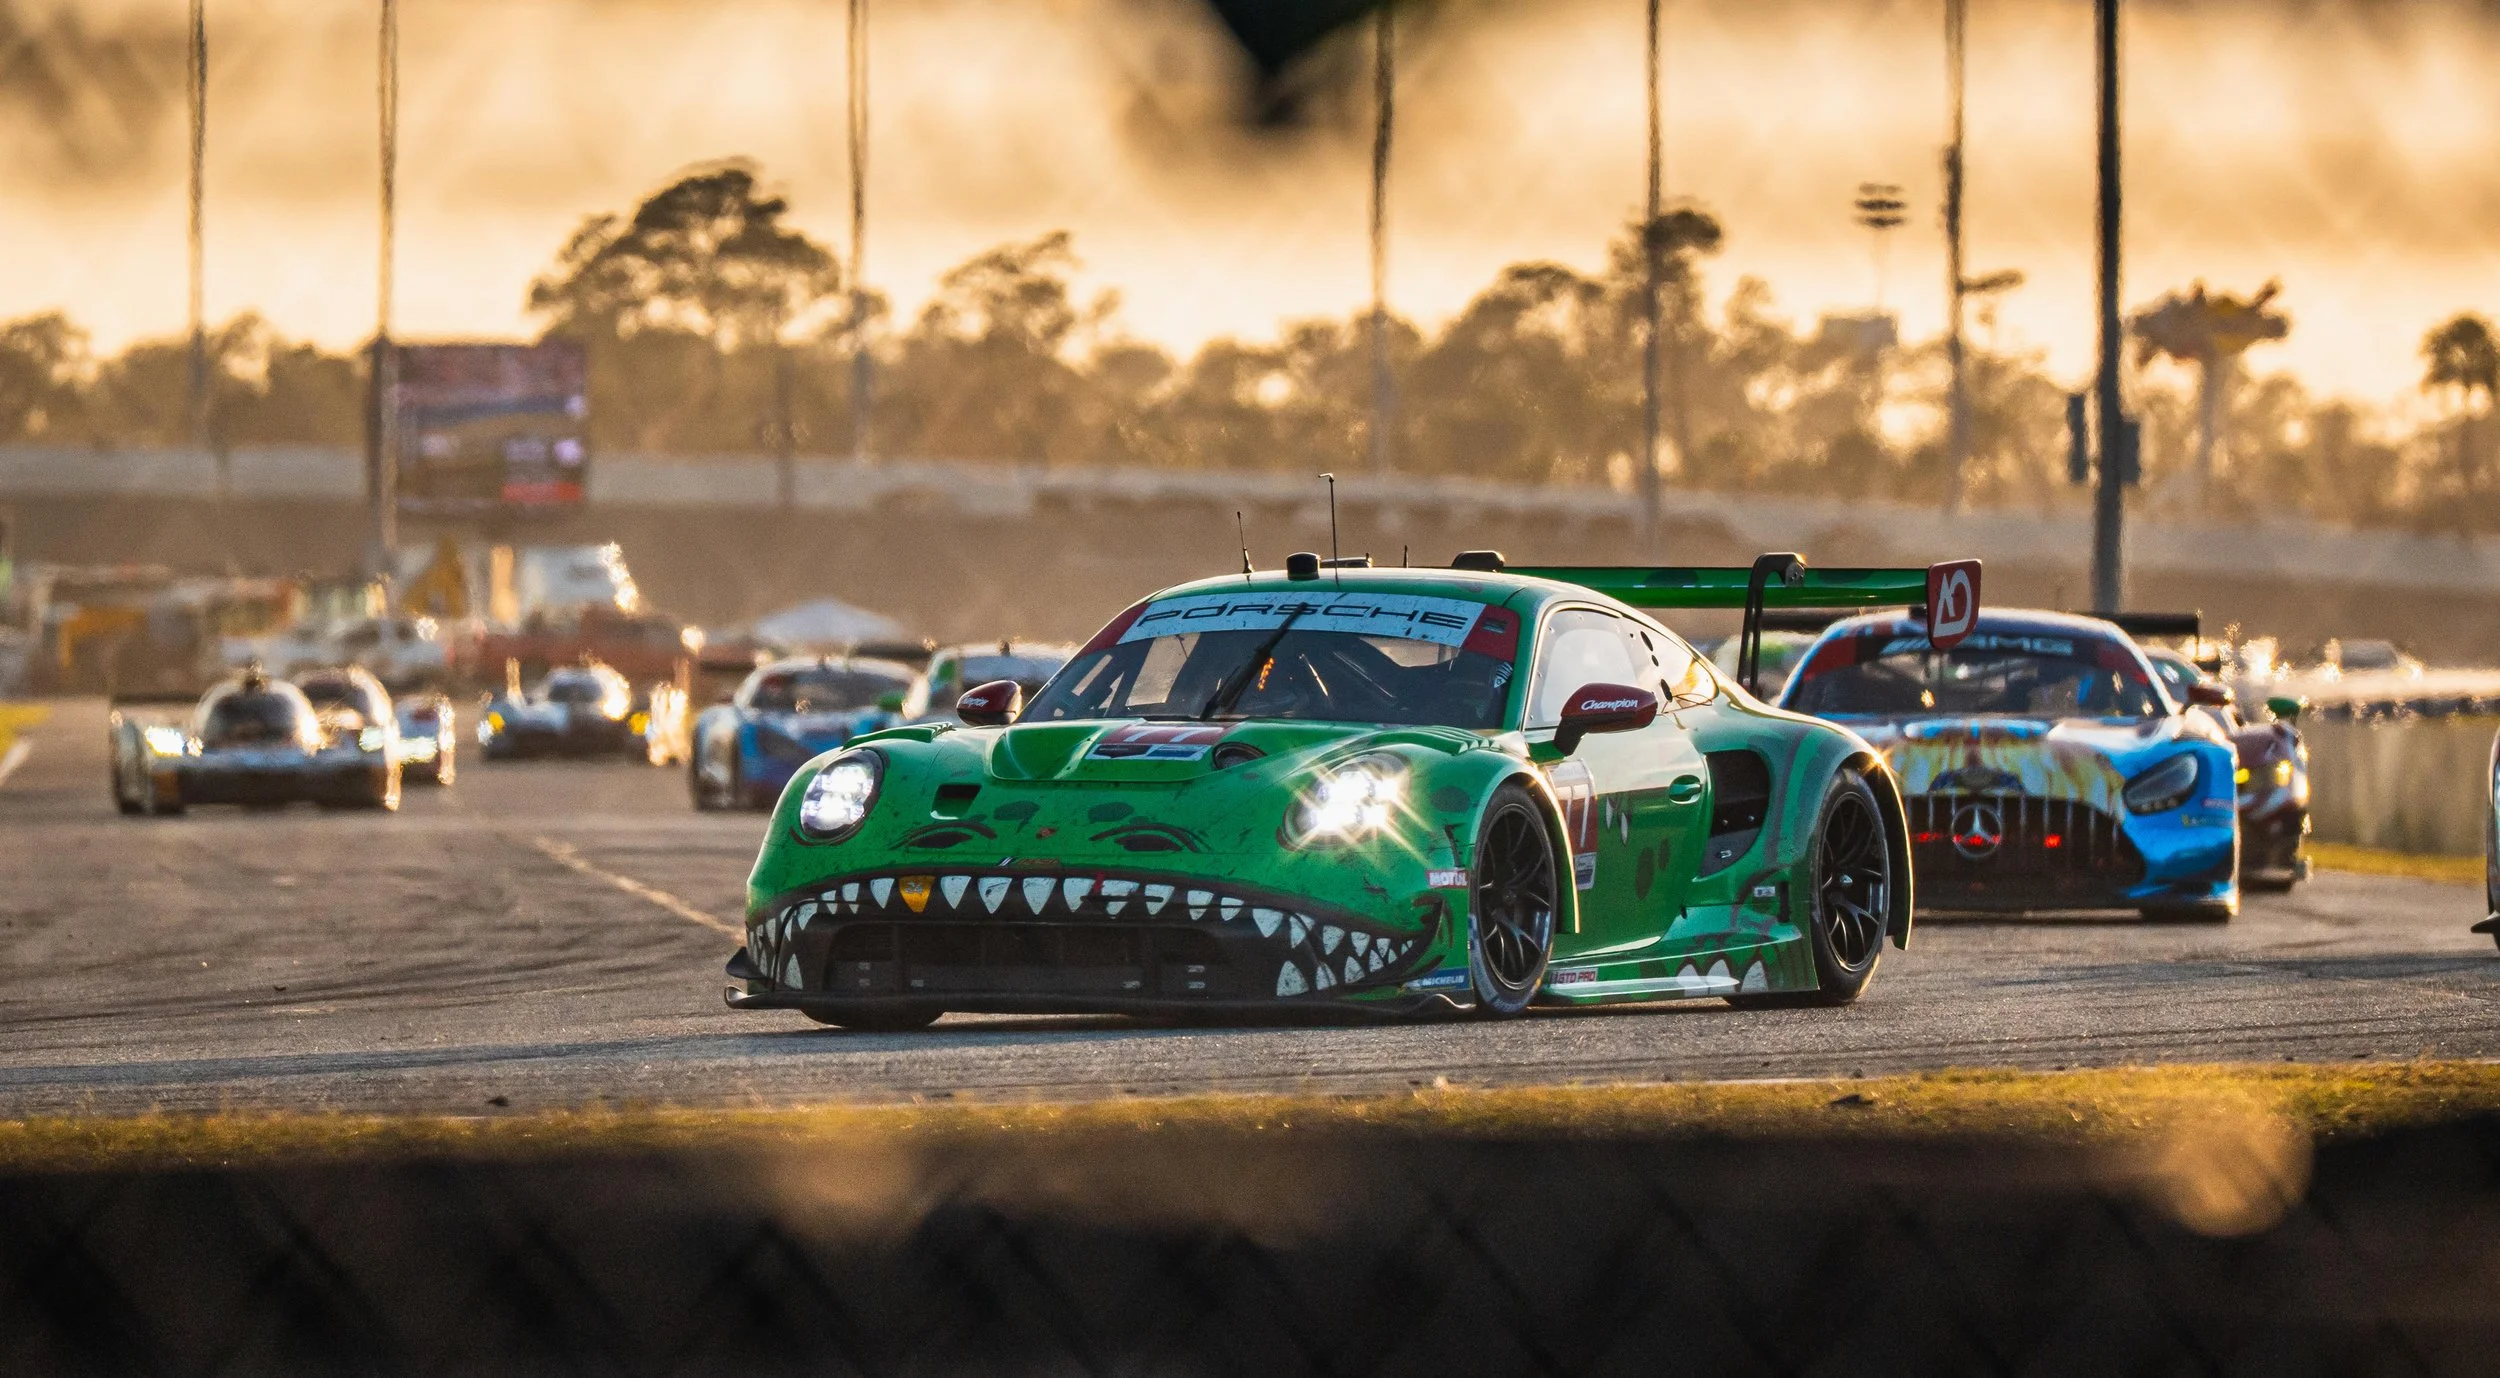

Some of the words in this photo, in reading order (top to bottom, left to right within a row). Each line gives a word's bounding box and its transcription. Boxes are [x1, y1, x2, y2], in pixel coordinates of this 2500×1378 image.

[1137, 601, 1469, 630] PORSCHE
[1581, 698, 1639, 712] Champion
[1123, 726, 1225, 743] 77
[1429, 871, 1467, 887] MOTUL
[1422, 974, 1465, 986] MICHELIN
